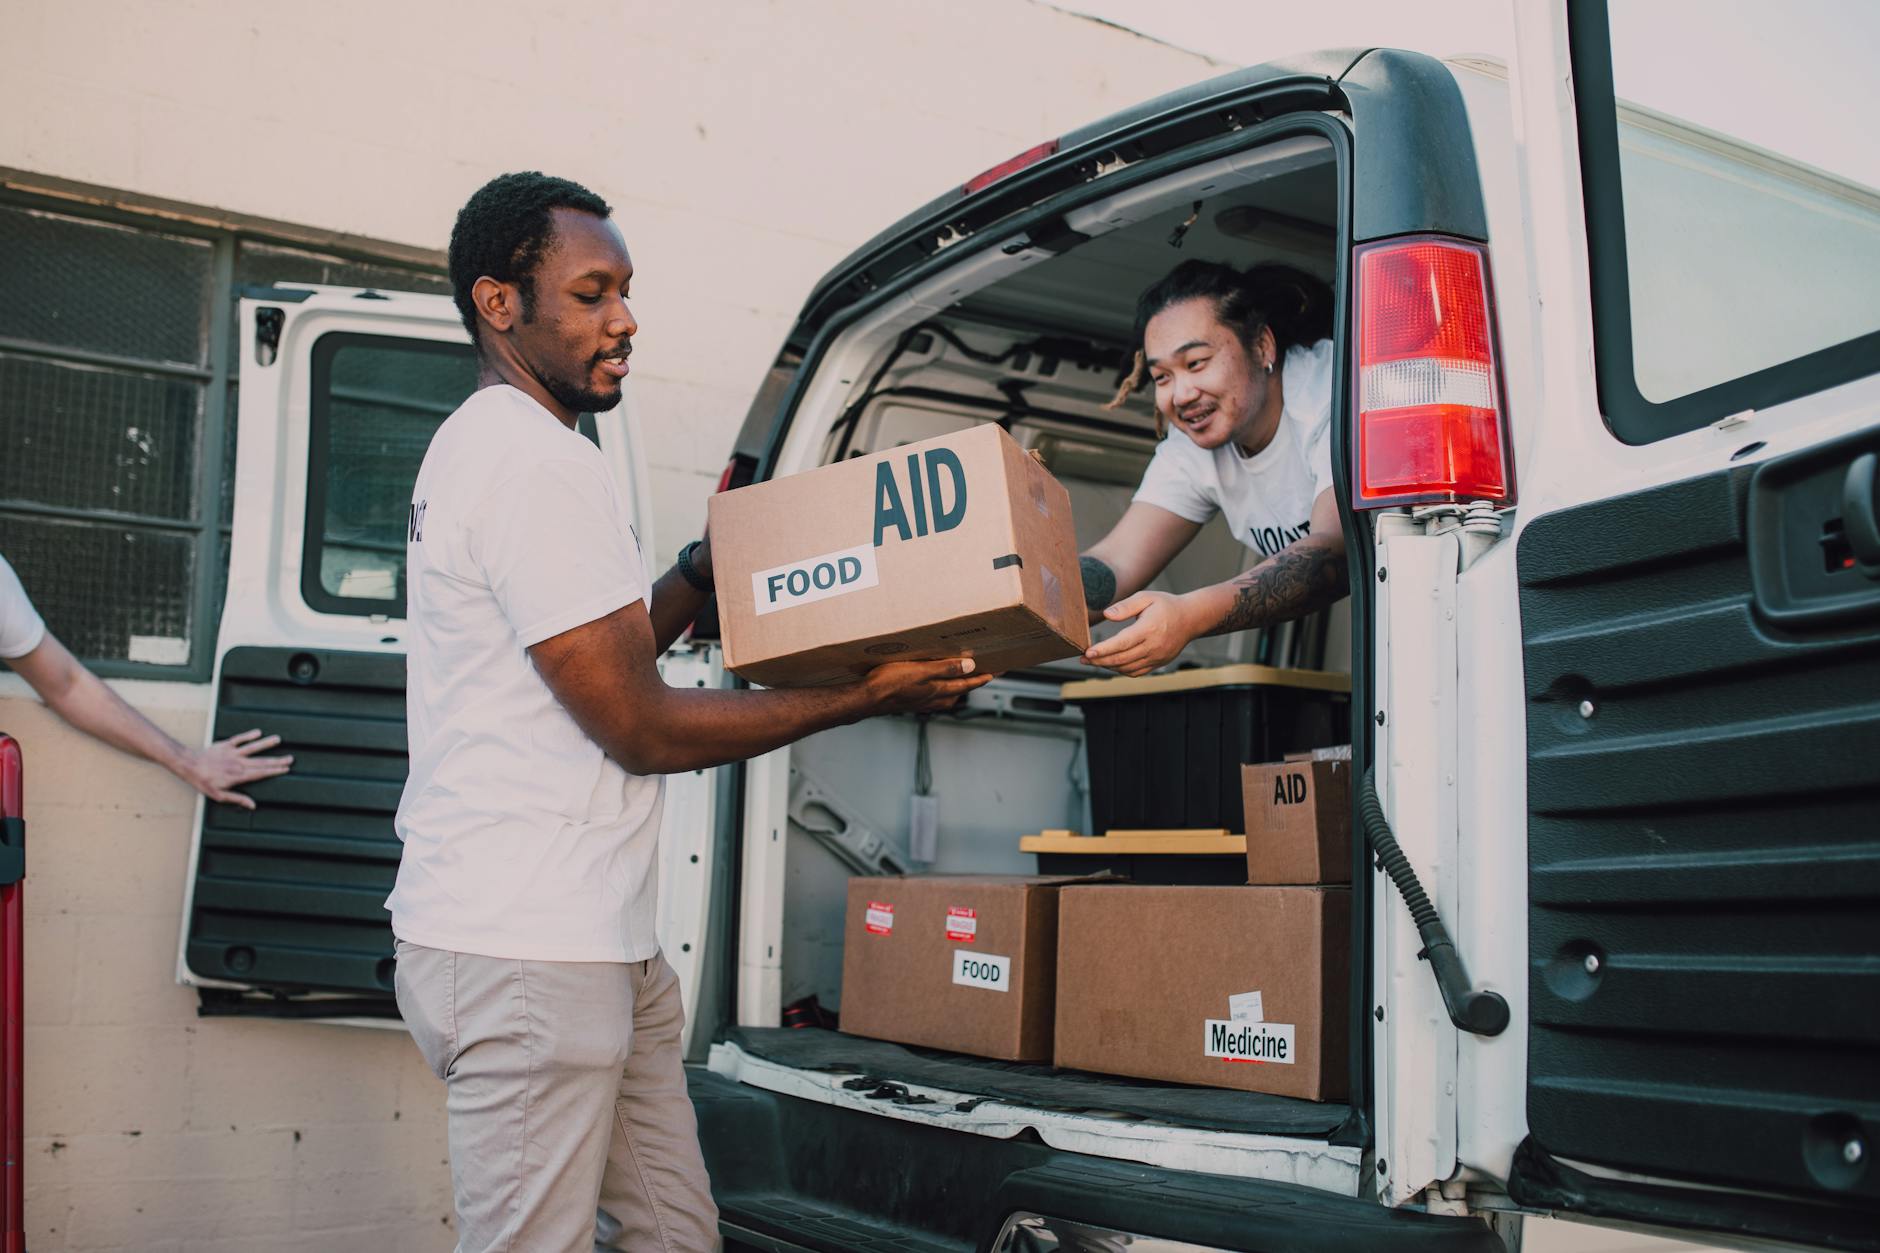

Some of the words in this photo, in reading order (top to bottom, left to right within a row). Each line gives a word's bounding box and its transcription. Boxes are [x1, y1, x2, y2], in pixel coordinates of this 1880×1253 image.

[873, 447, 968, 547] AID
[767, 556, 862, 602] FOOD
[1274, 773, 1307, 805] AID
[962, 959, 1000, 982] FOOD
[1211, 1023, 1288, 1059] Medicine
